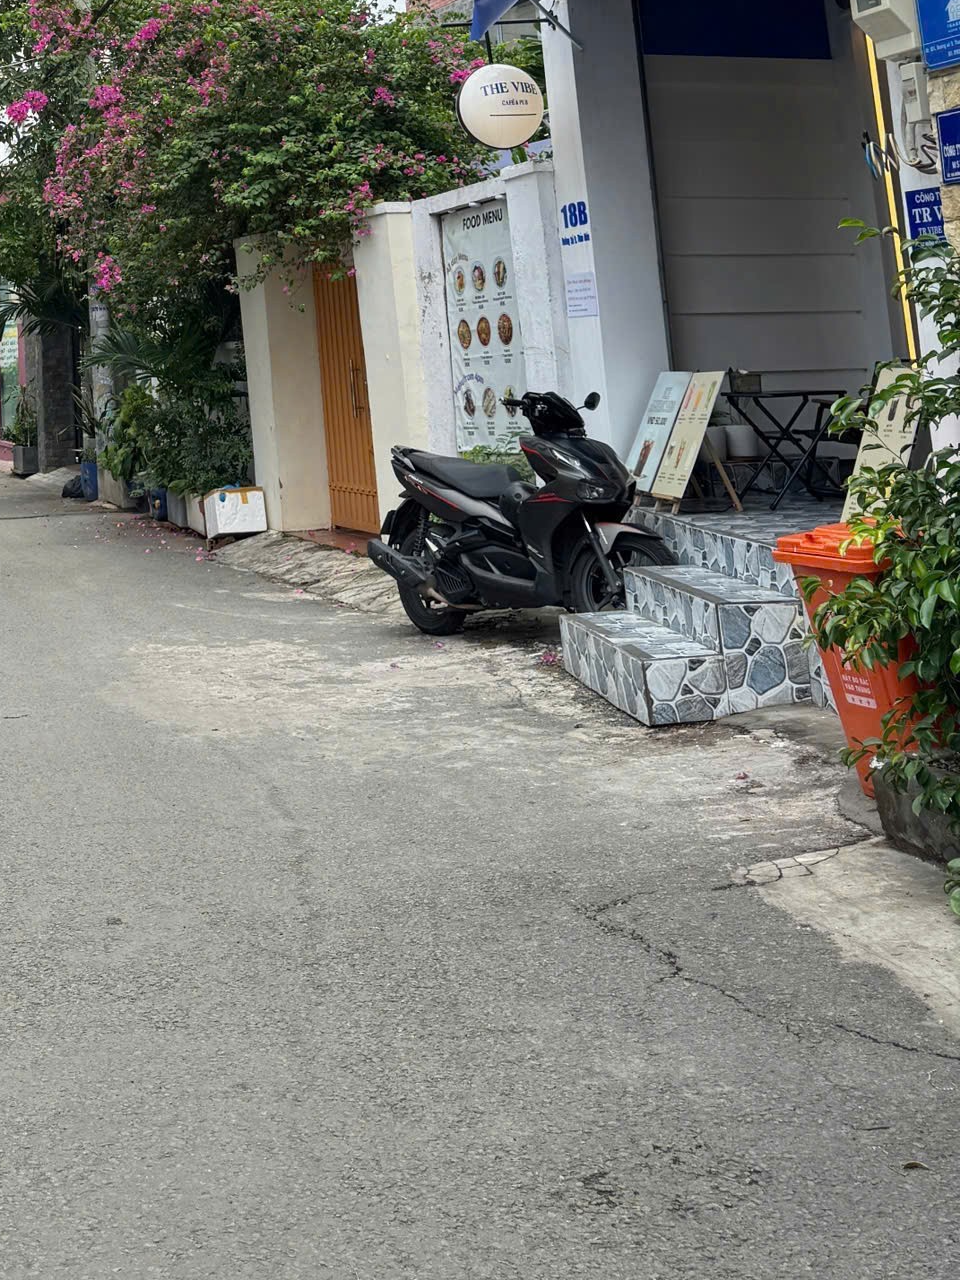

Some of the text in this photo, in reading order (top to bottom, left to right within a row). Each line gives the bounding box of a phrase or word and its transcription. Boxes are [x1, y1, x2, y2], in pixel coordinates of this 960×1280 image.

[480, 80, 538, 96] THE VIBE
[915, 192, 935, 204] CÔNG
[463, 208, 503, 231] FOOD MENU
[561, 201, 589, 229] 18B
[912, 207, 932, 224] TR
